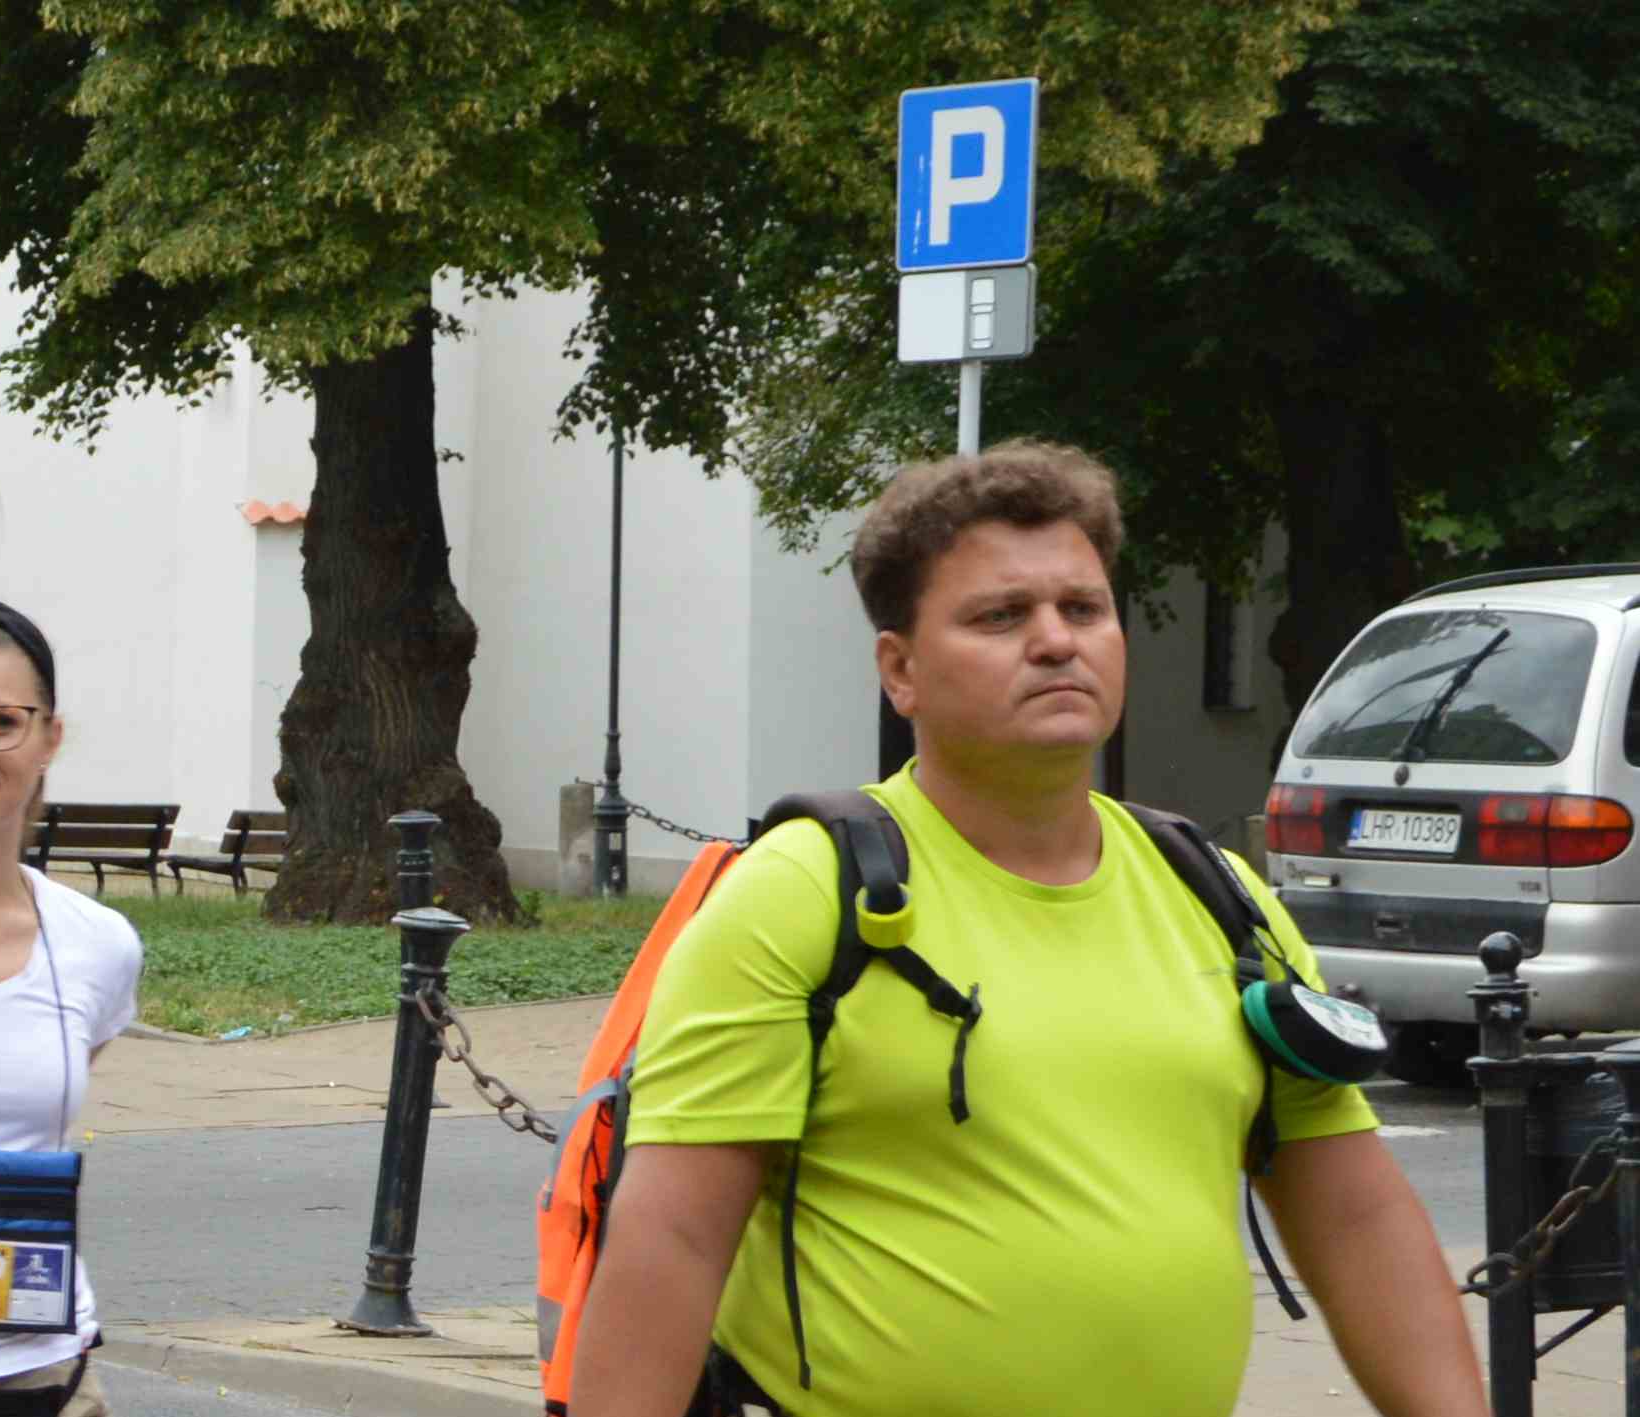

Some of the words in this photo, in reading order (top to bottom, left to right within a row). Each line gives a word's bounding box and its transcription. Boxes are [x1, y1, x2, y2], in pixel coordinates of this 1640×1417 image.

[928, 105, 1006, 247] P
[1361, 812, 1395, 841] LHR
[1402, 815, 1459, 845] 10389
